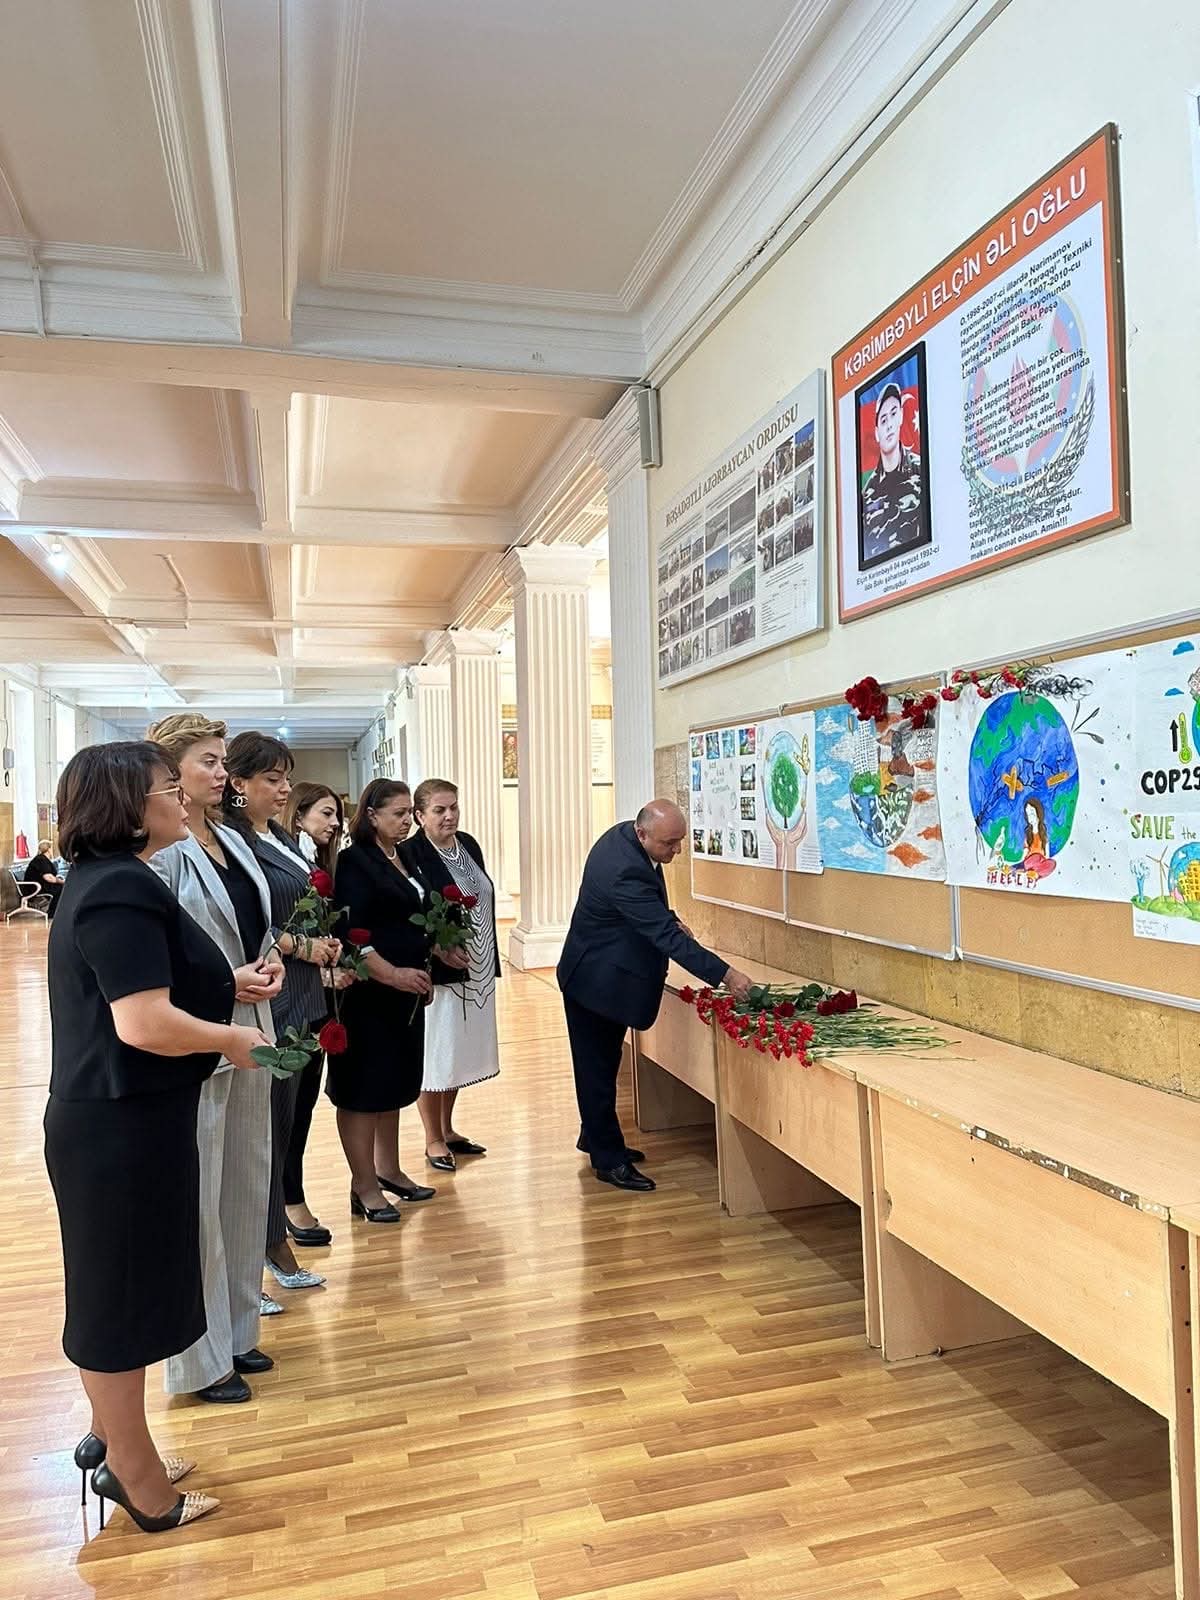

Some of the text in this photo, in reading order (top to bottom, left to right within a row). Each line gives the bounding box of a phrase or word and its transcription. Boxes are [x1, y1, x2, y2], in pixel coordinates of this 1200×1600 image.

[844, 167, 1085, 378] KƏRİMBƏYLİ ELÇİN ƏLİ OĞLU
[1029, 240, 1071, 276] Nərimanov
[960, 309, 992, 336] rayonunda
[1062, 236, 1091, 265] Texniki
[960, 321, 992, 347] Humanitar
[1029, 258, 1080, 300] 2007-2010-cu
[1029, 279, 1070, 311] rayonunda
[988, 341, 992, 350] 3
[1021, 311, 1037, 329] Bakı
[1037, 355, 1047, 367] bir
[1049, 347, 1064, 361] çox
[976, 411, 996, 426] zaman
[1055, 357, 1089, 382] arasında
[1024, 411, 1037, 423] baş
[702, 440, 755, 497] AZƏRBAYCAN
[756, 403, 798, 451] ORDUSU
[1024, 466, 1041, 481] Elçin
[1040, 515, 1067, 533] Amin!!!
[1130, 814, 1175, 840] SAVE
